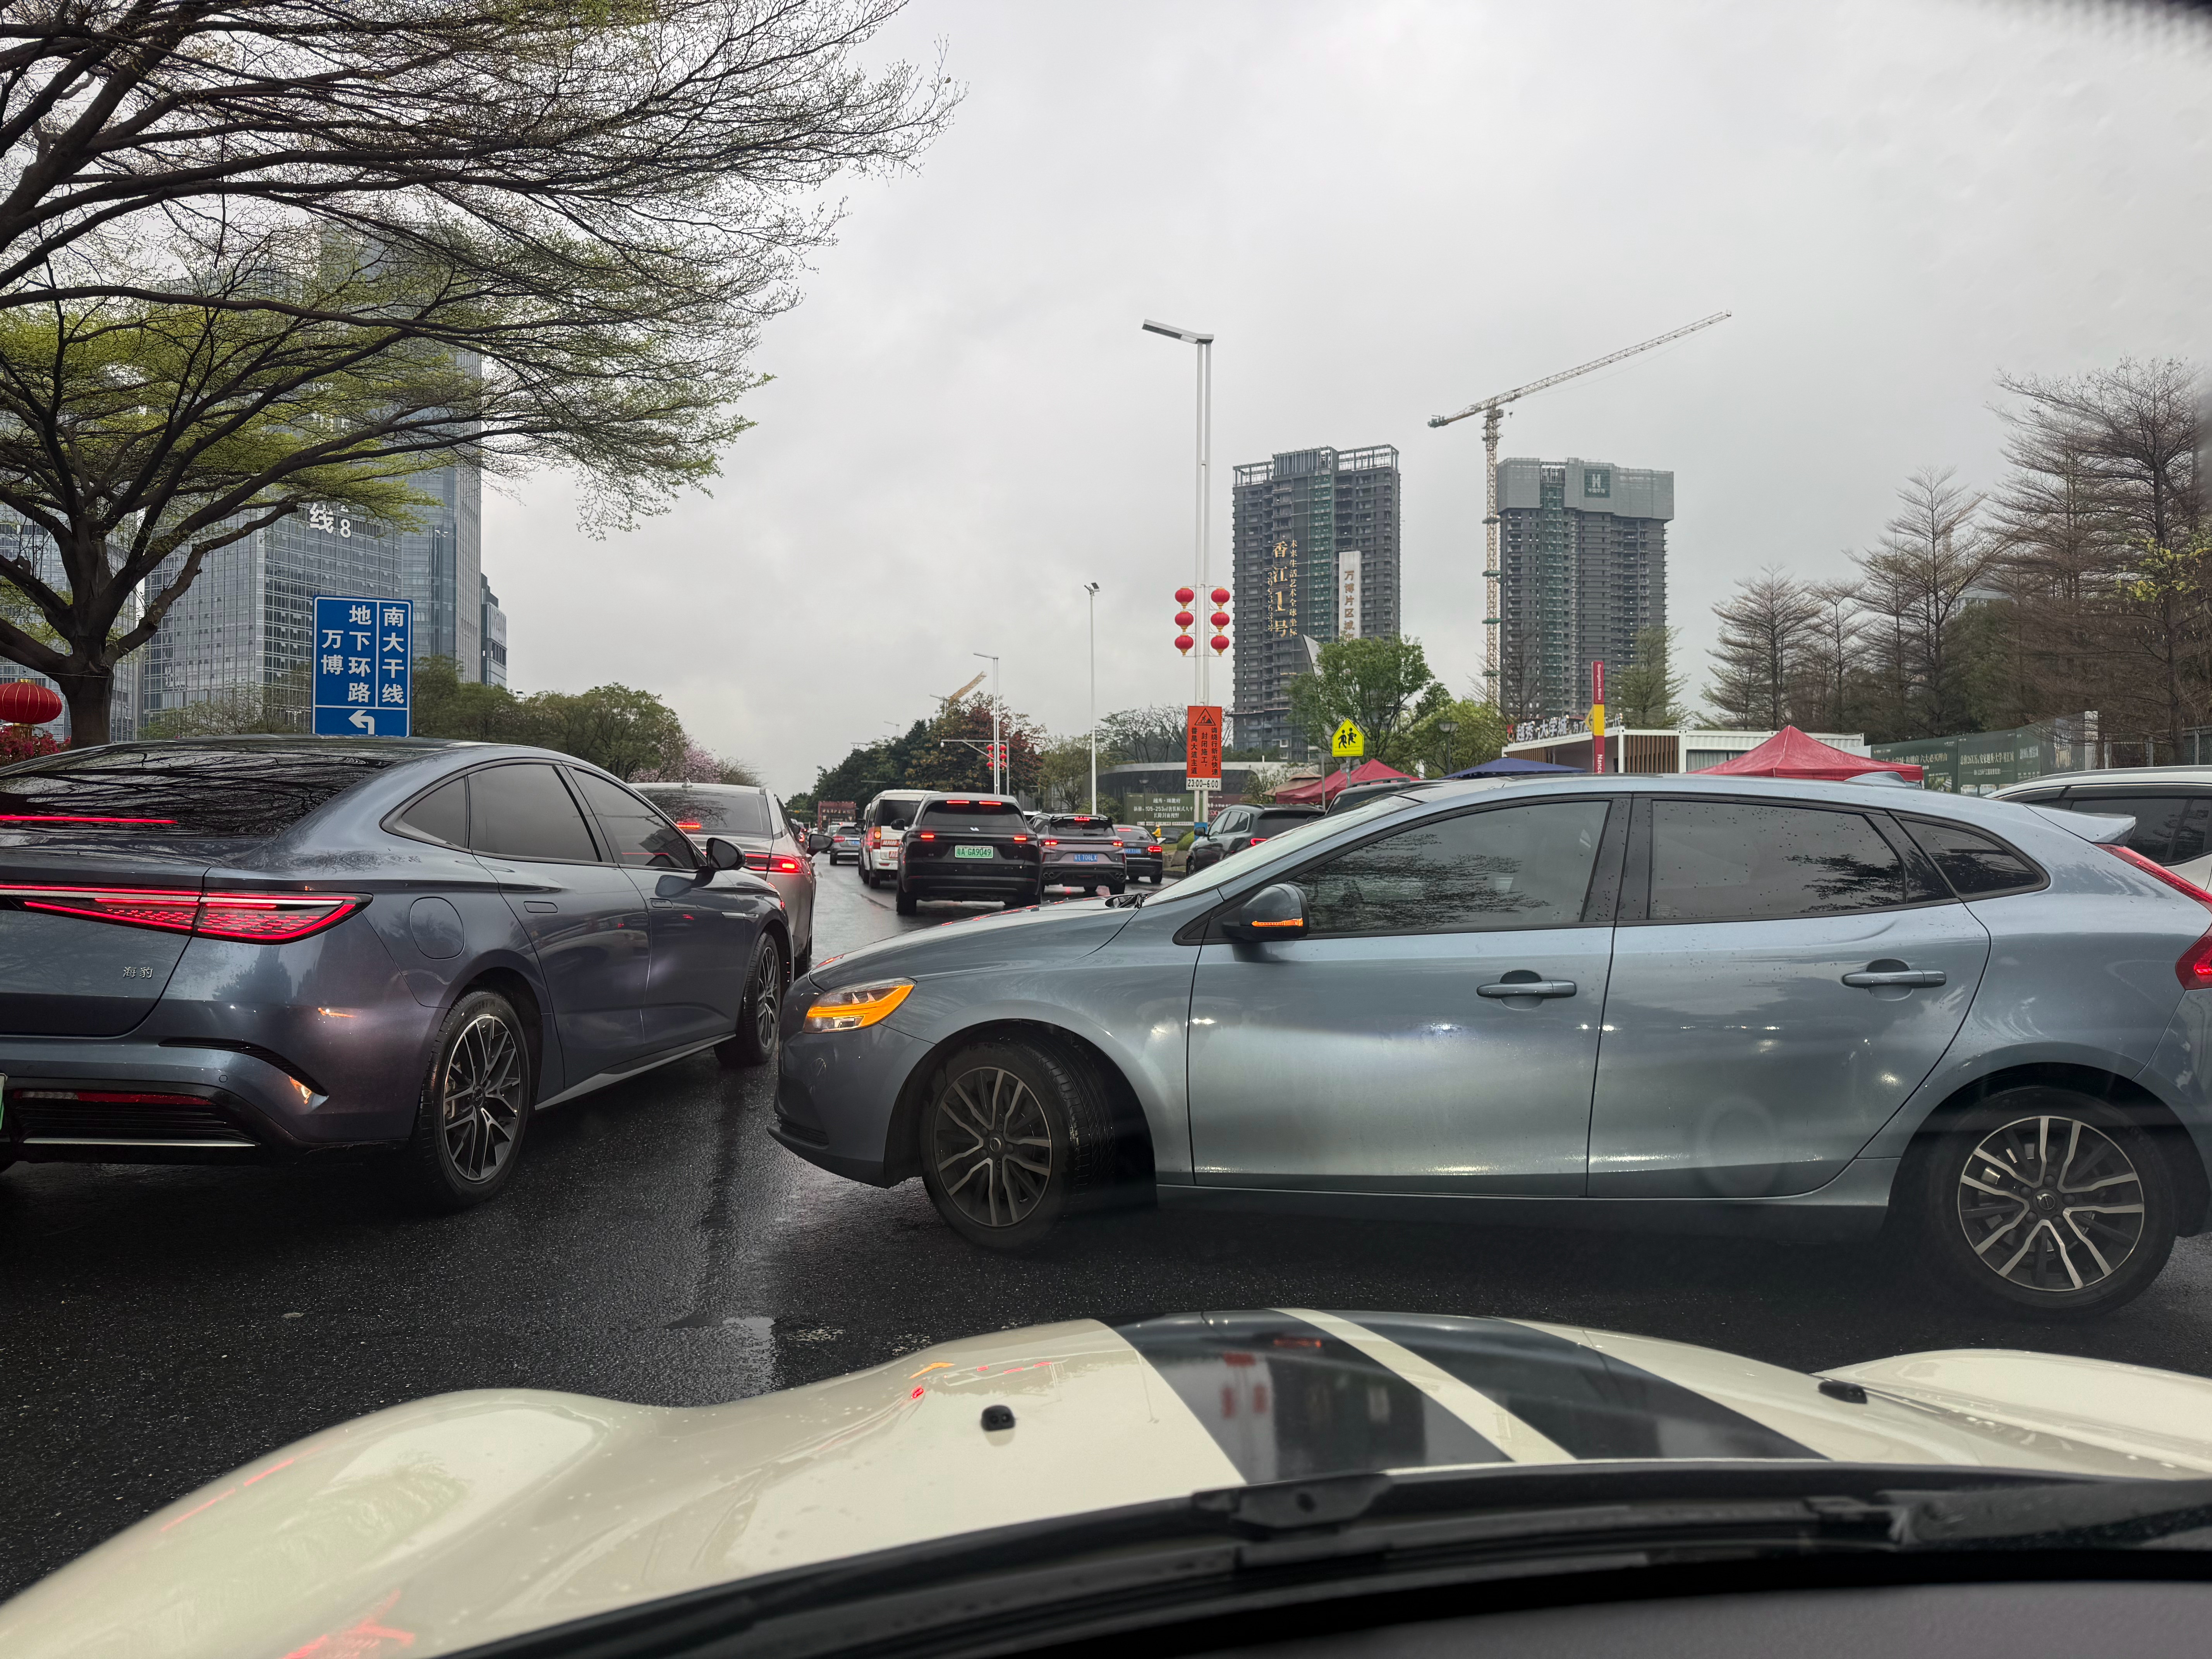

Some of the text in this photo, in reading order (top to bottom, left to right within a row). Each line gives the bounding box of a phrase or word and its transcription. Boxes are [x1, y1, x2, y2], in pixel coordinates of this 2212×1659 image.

[1273, 541, 1288, 637] 香江1号
[321, 629, 344, 675] 万博
[347, 605, 372, 703] 地下环路
[381, 607, 405, 704] 南大干线
[123, 967, 153, 978] 海豹
